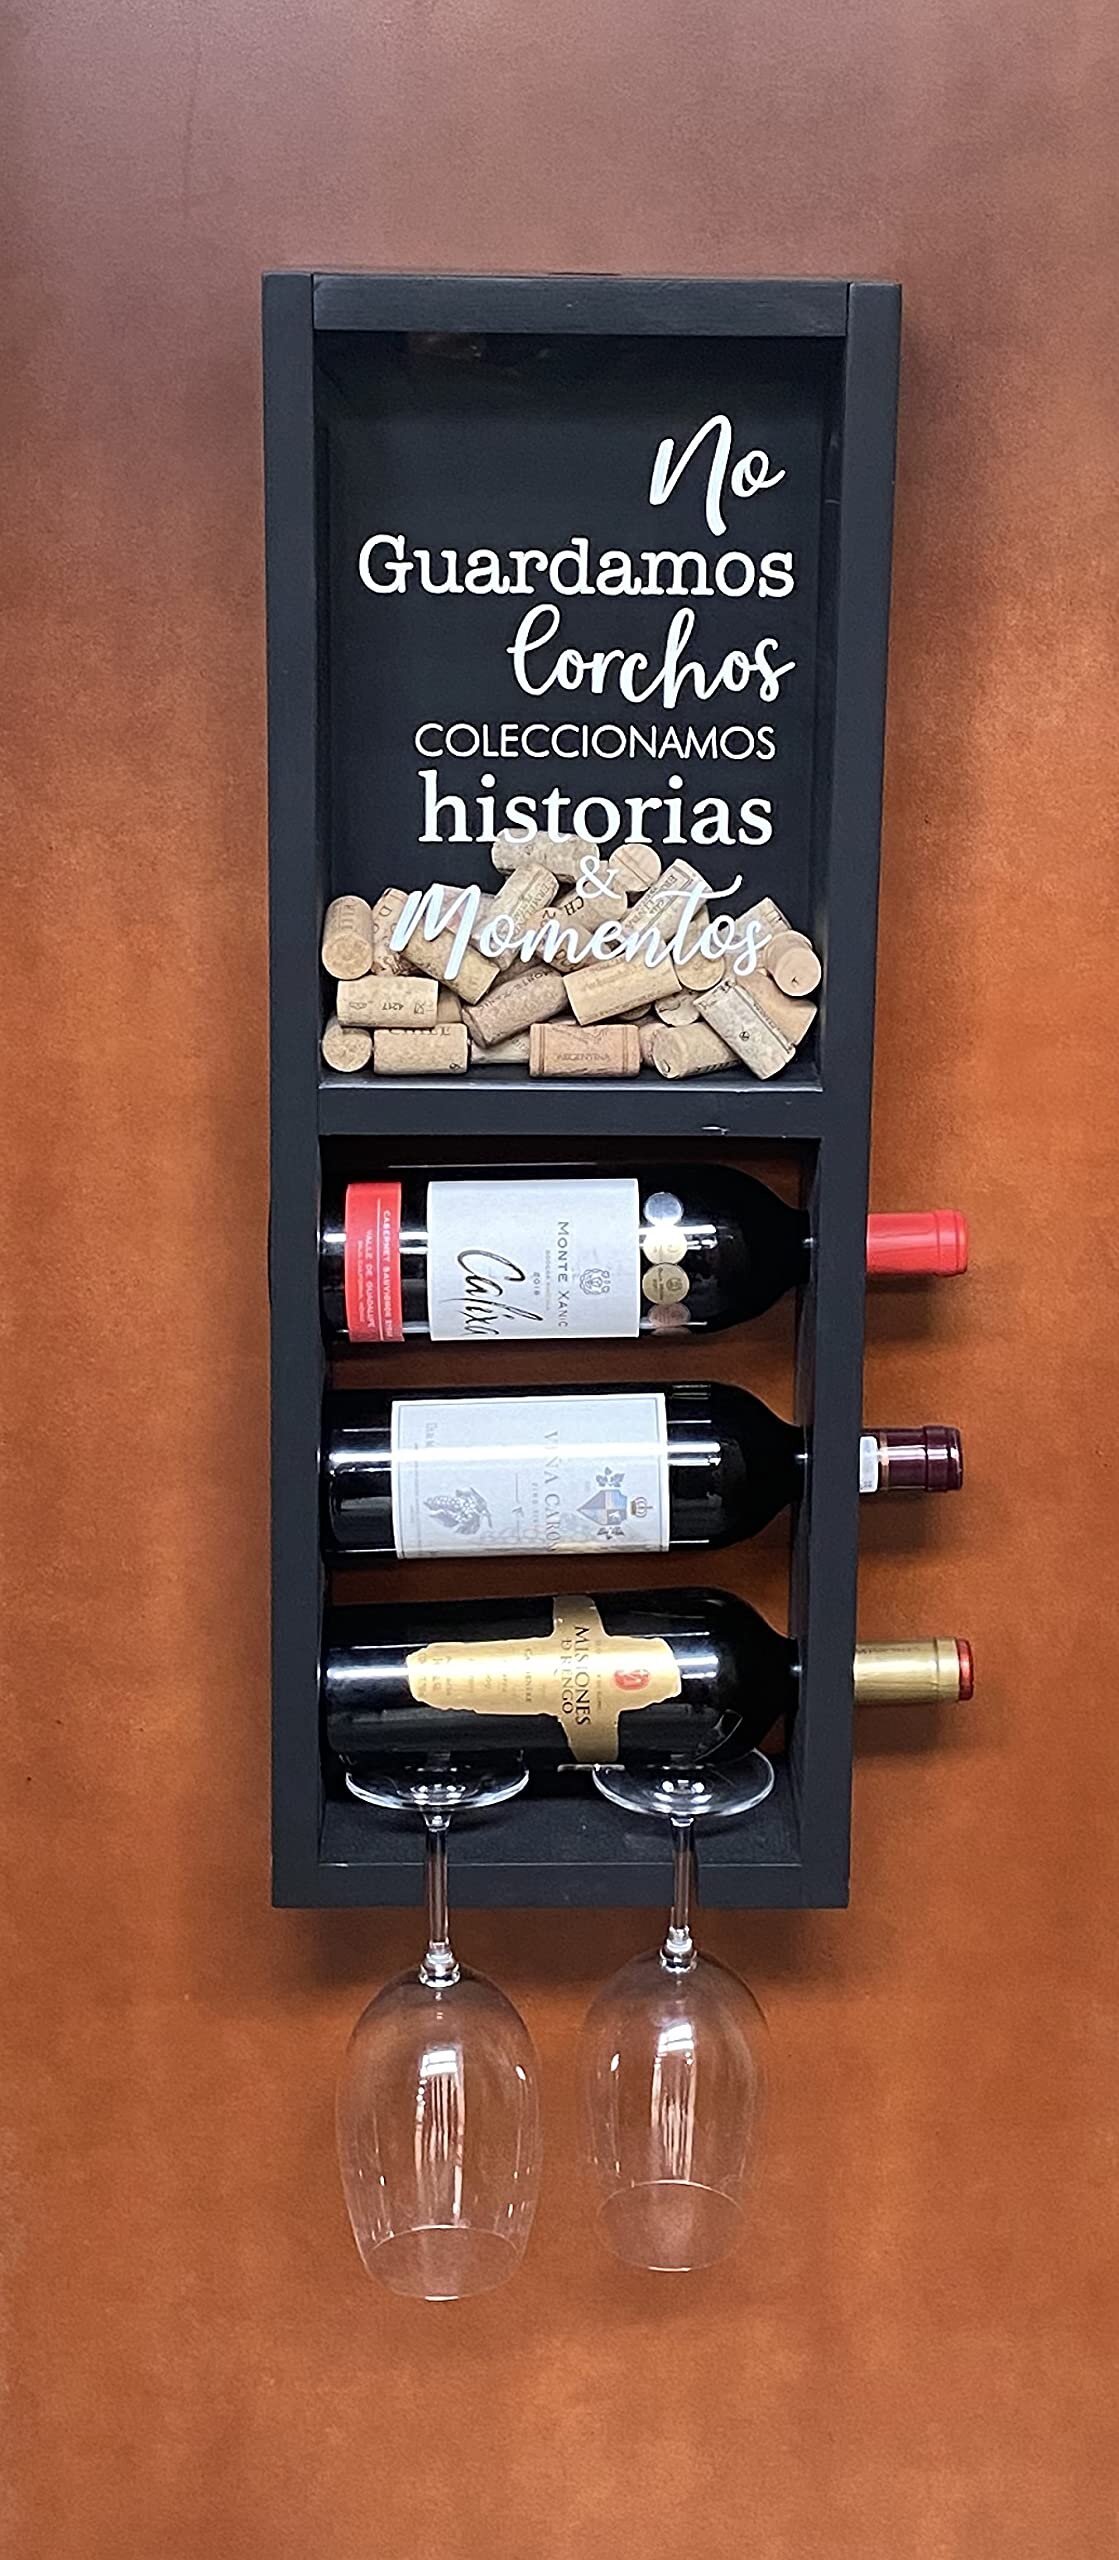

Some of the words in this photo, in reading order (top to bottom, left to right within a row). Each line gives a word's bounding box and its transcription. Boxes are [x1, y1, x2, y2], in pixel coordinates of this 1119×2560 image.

[650, 414, 786, 537] No
[358, 533, 795, 598] Guardamos
[506, 603, 796, 709] Corchos
[414, 722, 777, 760] COLECCIONAMOS
[417, 768, 773, 845] historias
[575, 854, 623, 899] &
[389, 873, 773, 980] Momentos
[382, 1210, 392, 1262] CABERNET
[557, 1220, 570, 1283] MONTE
[441, 1249, 544, 1337] Calixa
[557, 1289, 570, 1328] XANIC
[573, 1624, 591, 1726] MISIONES
